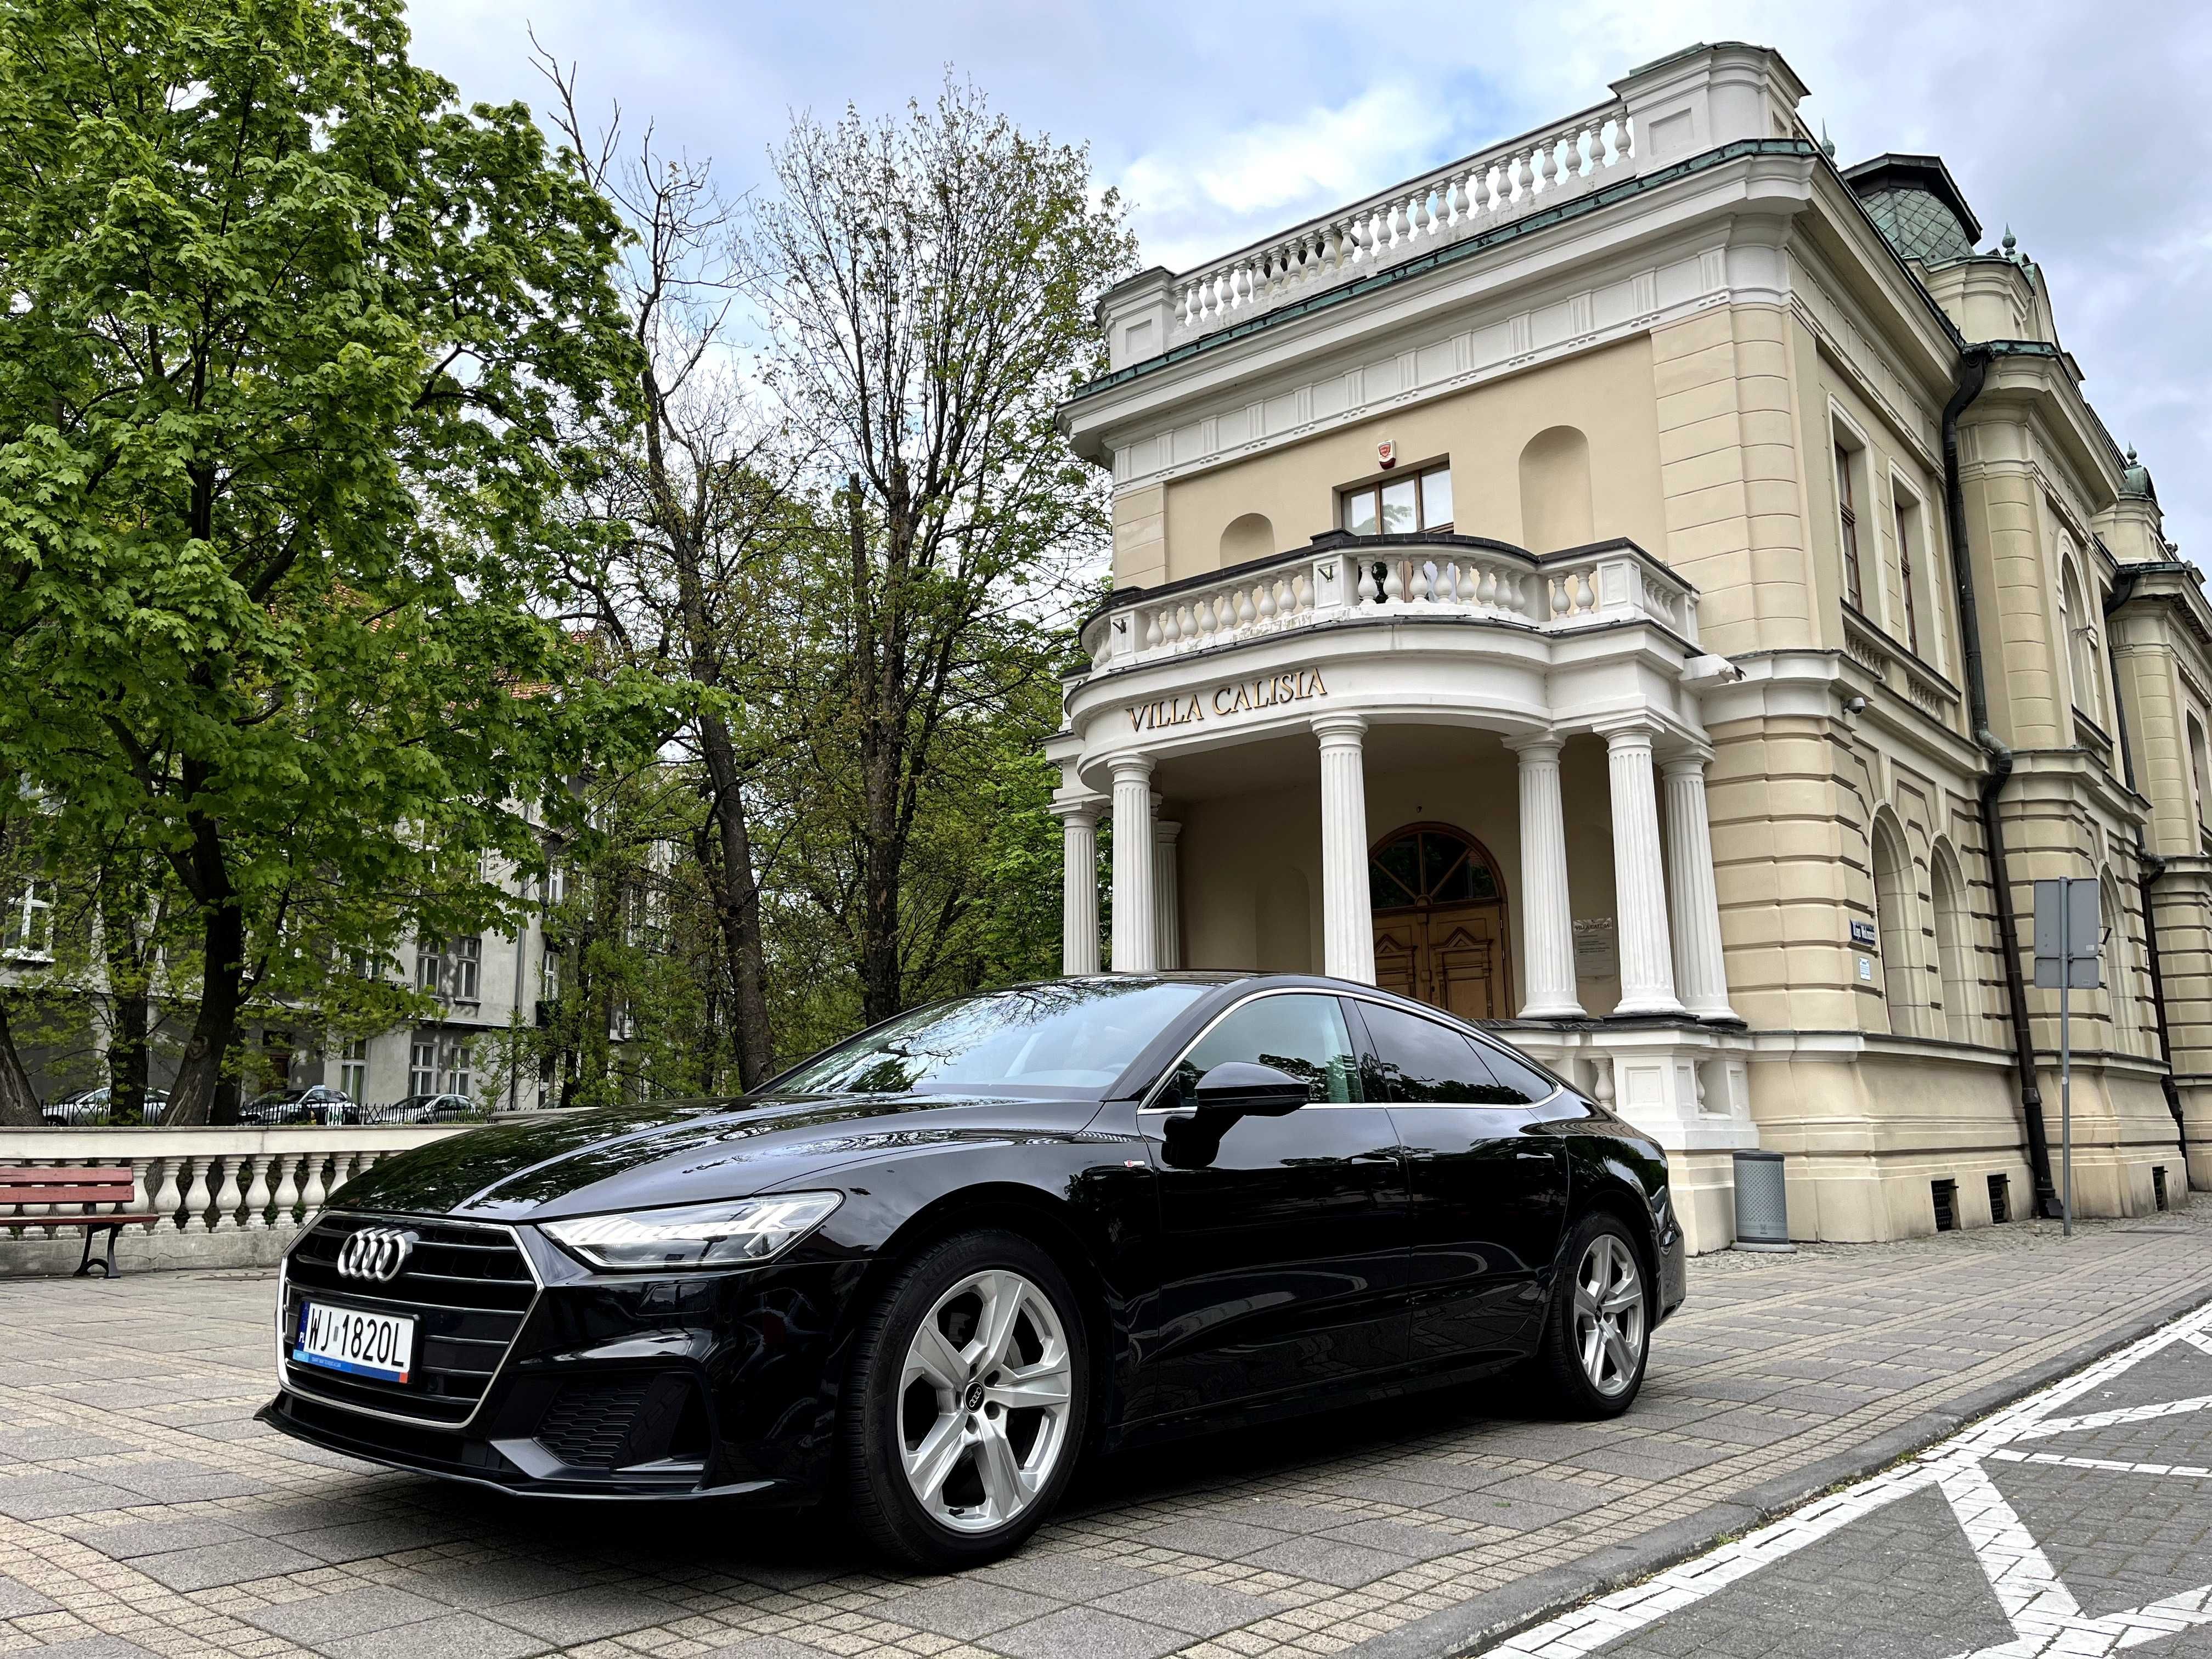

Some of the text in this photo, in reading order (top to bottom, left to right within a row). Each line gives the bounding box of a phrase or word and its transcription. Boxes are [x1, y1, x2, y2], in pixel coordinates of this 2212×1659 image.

[1125, 667, 1327, 732] VILLA CALISIA
[308, 1308, 404, 1368] WJ 1820L
